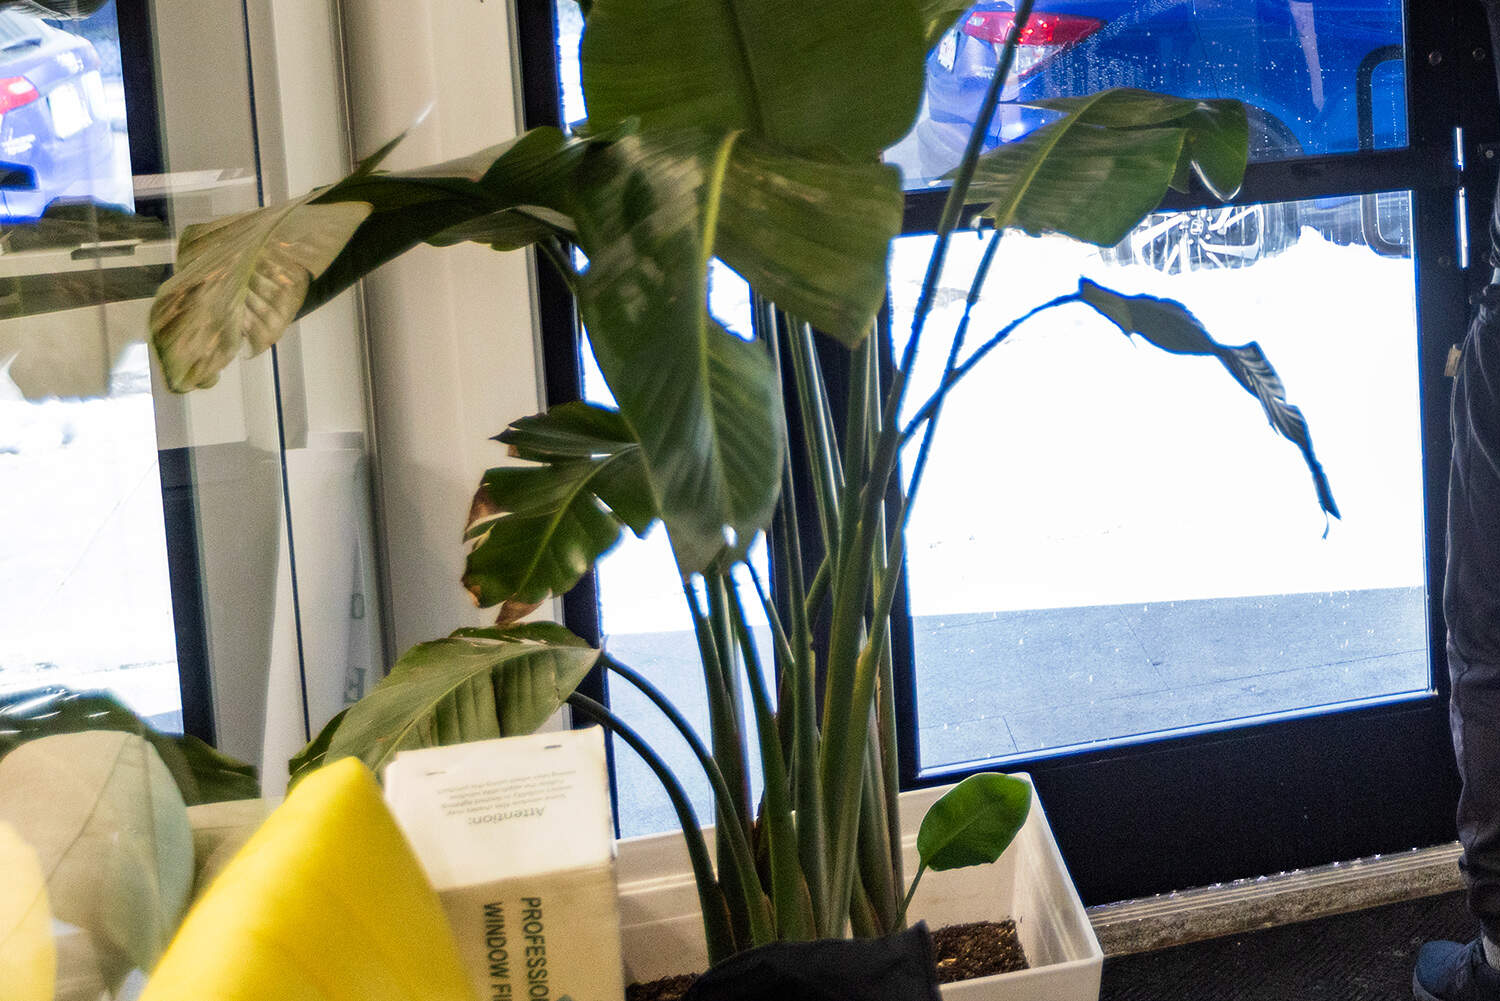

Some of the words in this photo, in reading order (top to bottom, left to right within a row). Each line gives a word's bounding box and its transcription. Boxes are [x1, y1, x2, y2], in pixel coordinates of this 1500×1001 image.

[483, 902, 511, 979] WINDOW
[520, 897, 551, 1001] PROFESSIO
[491, 984, 513, 1001] FI
